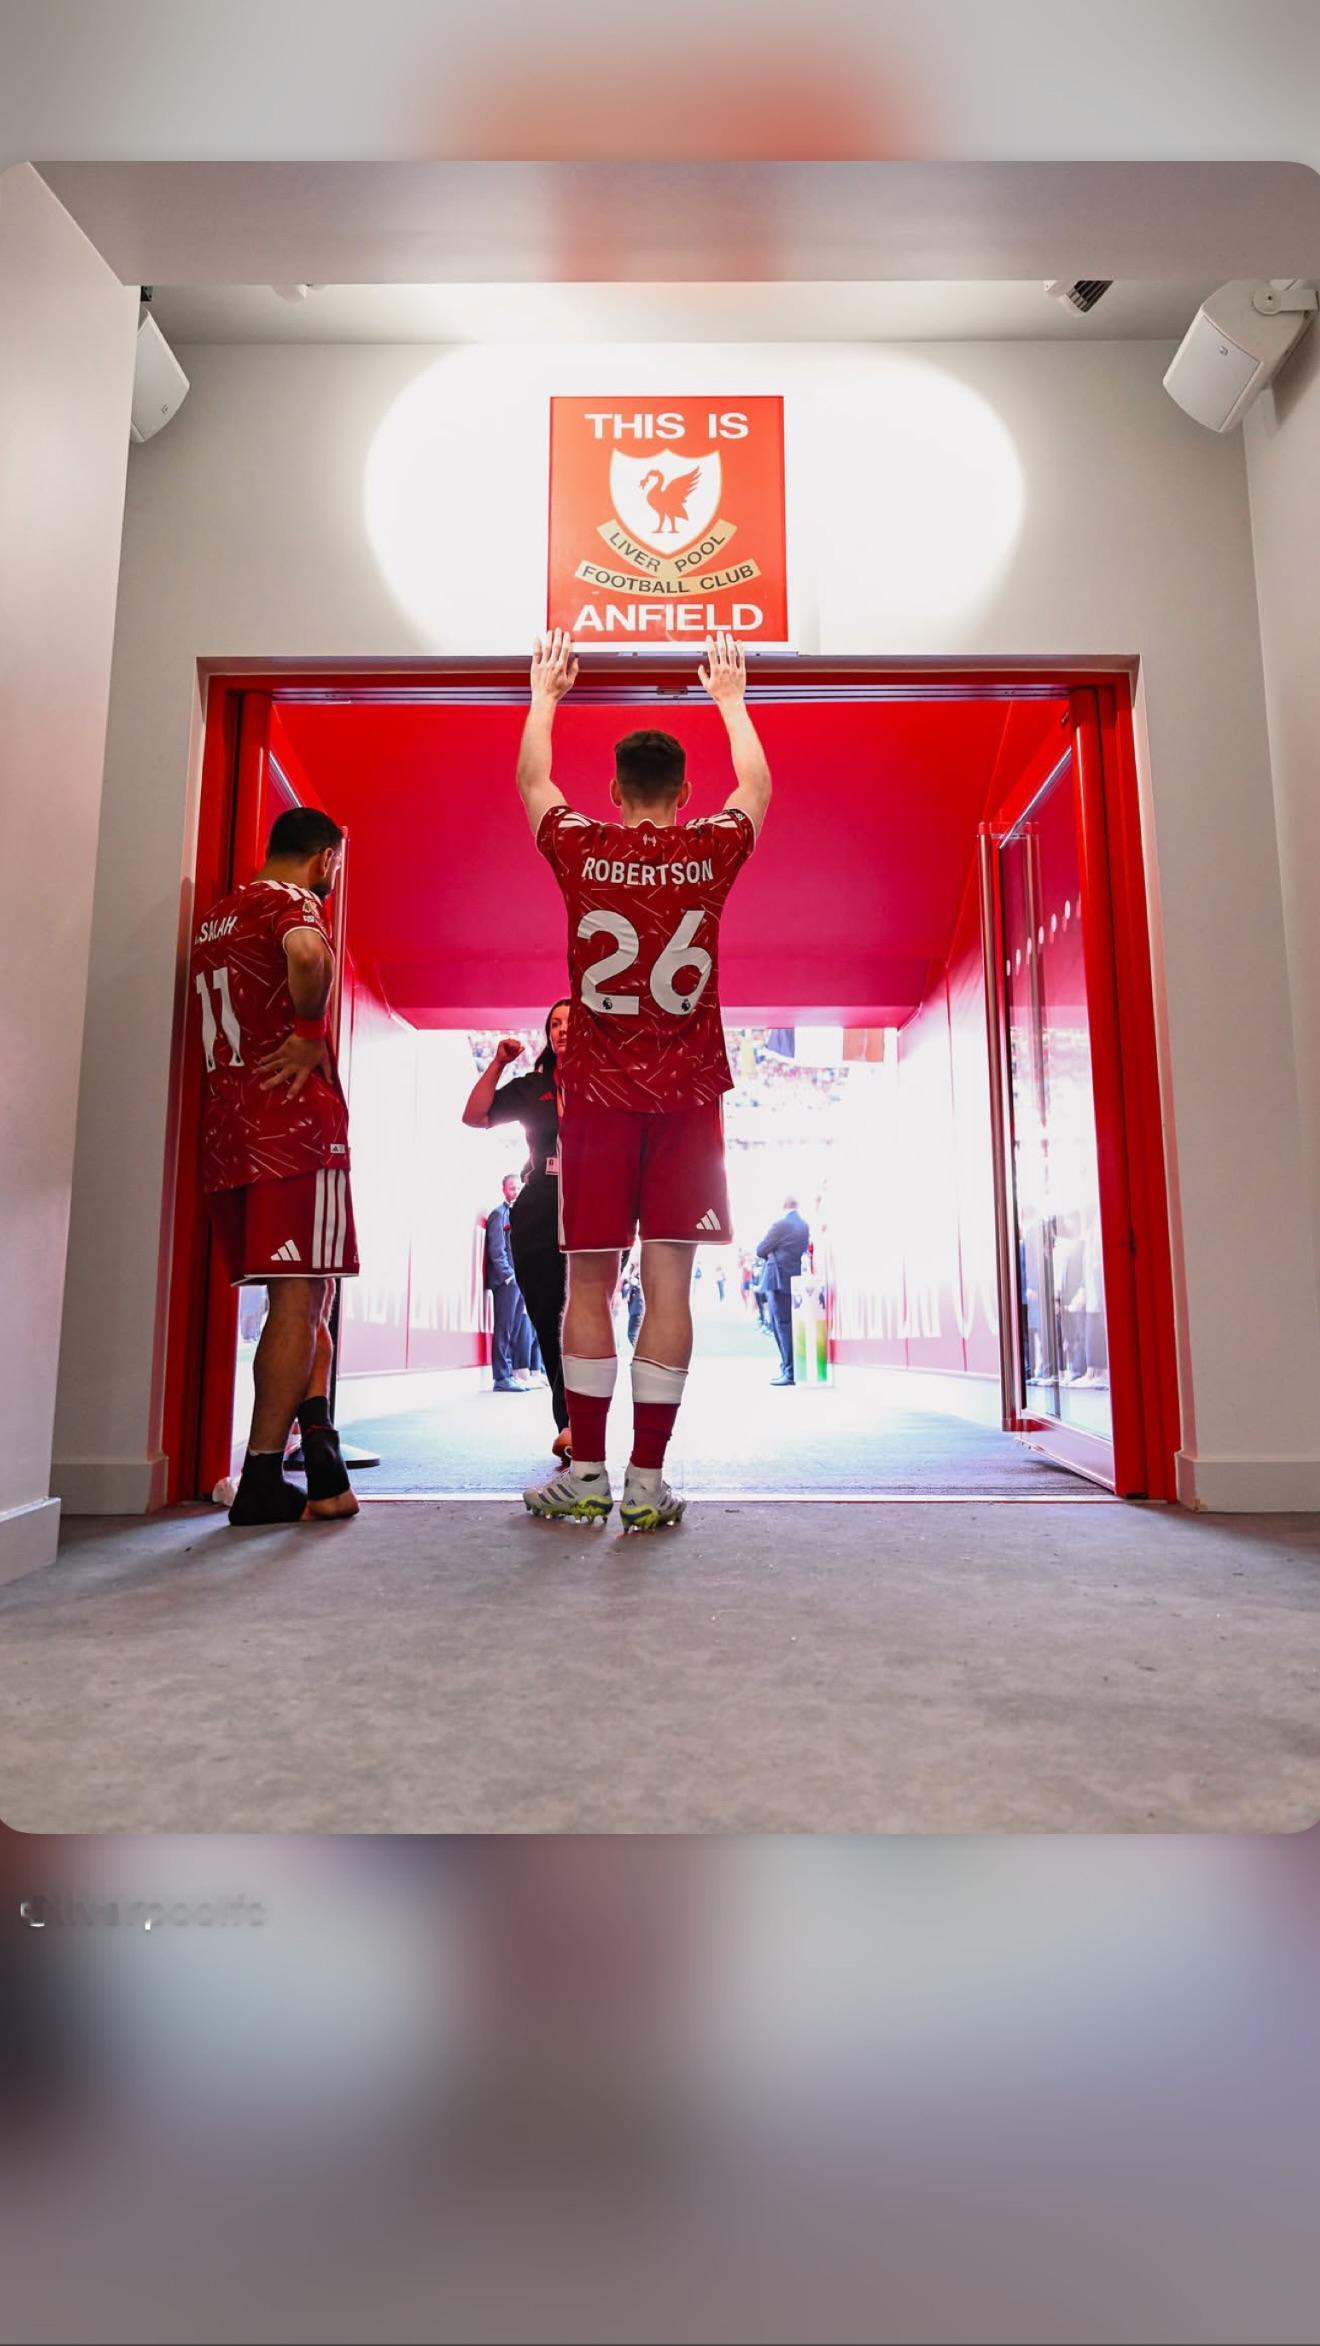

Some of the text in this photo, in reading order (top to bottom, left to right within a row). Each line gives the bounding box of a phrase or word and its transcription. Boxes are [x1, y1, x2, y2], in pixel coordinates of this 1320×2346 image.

[585, 412, 749, 439] THIS IS
[609, 532, 726, 572] LIVER POOL
[582, 564, 754, 594] FOOTBALL CLUB
[572, 603, 763, 631] ANFIELD
[581, 857, 714, 886] ROBERTSON
[576, 909, 713, 1016] 26
[196, 966, 245, 1072] 11
